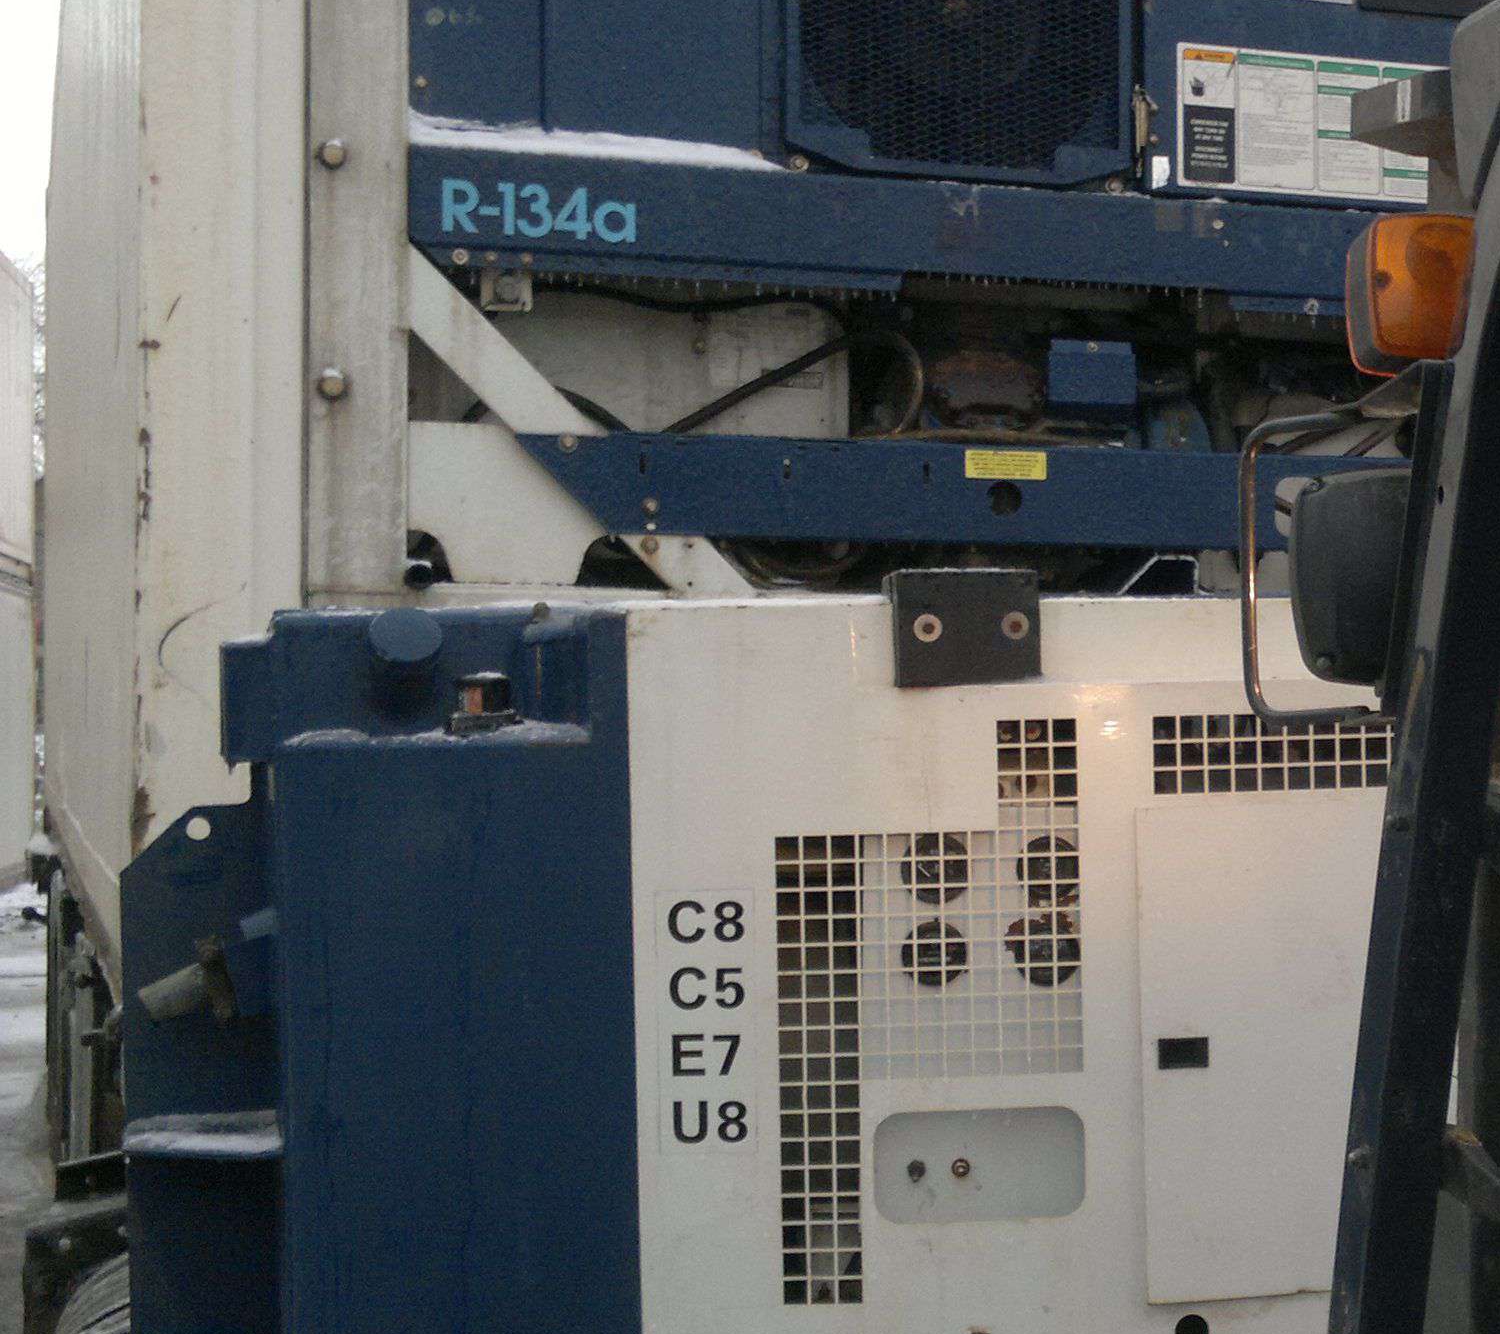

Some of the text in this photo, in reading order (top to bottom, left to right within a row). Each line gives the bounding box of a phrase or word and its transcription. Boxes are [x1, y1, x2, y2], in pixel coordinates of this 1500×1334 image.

[442, 177, 638, 244] R-134a
[667, 900, 746, 944] C8
[669, 966, 747, 1011] C5
[671, 1033, 742, 1078] E7
[672, 1100, 749, 1145] U8
